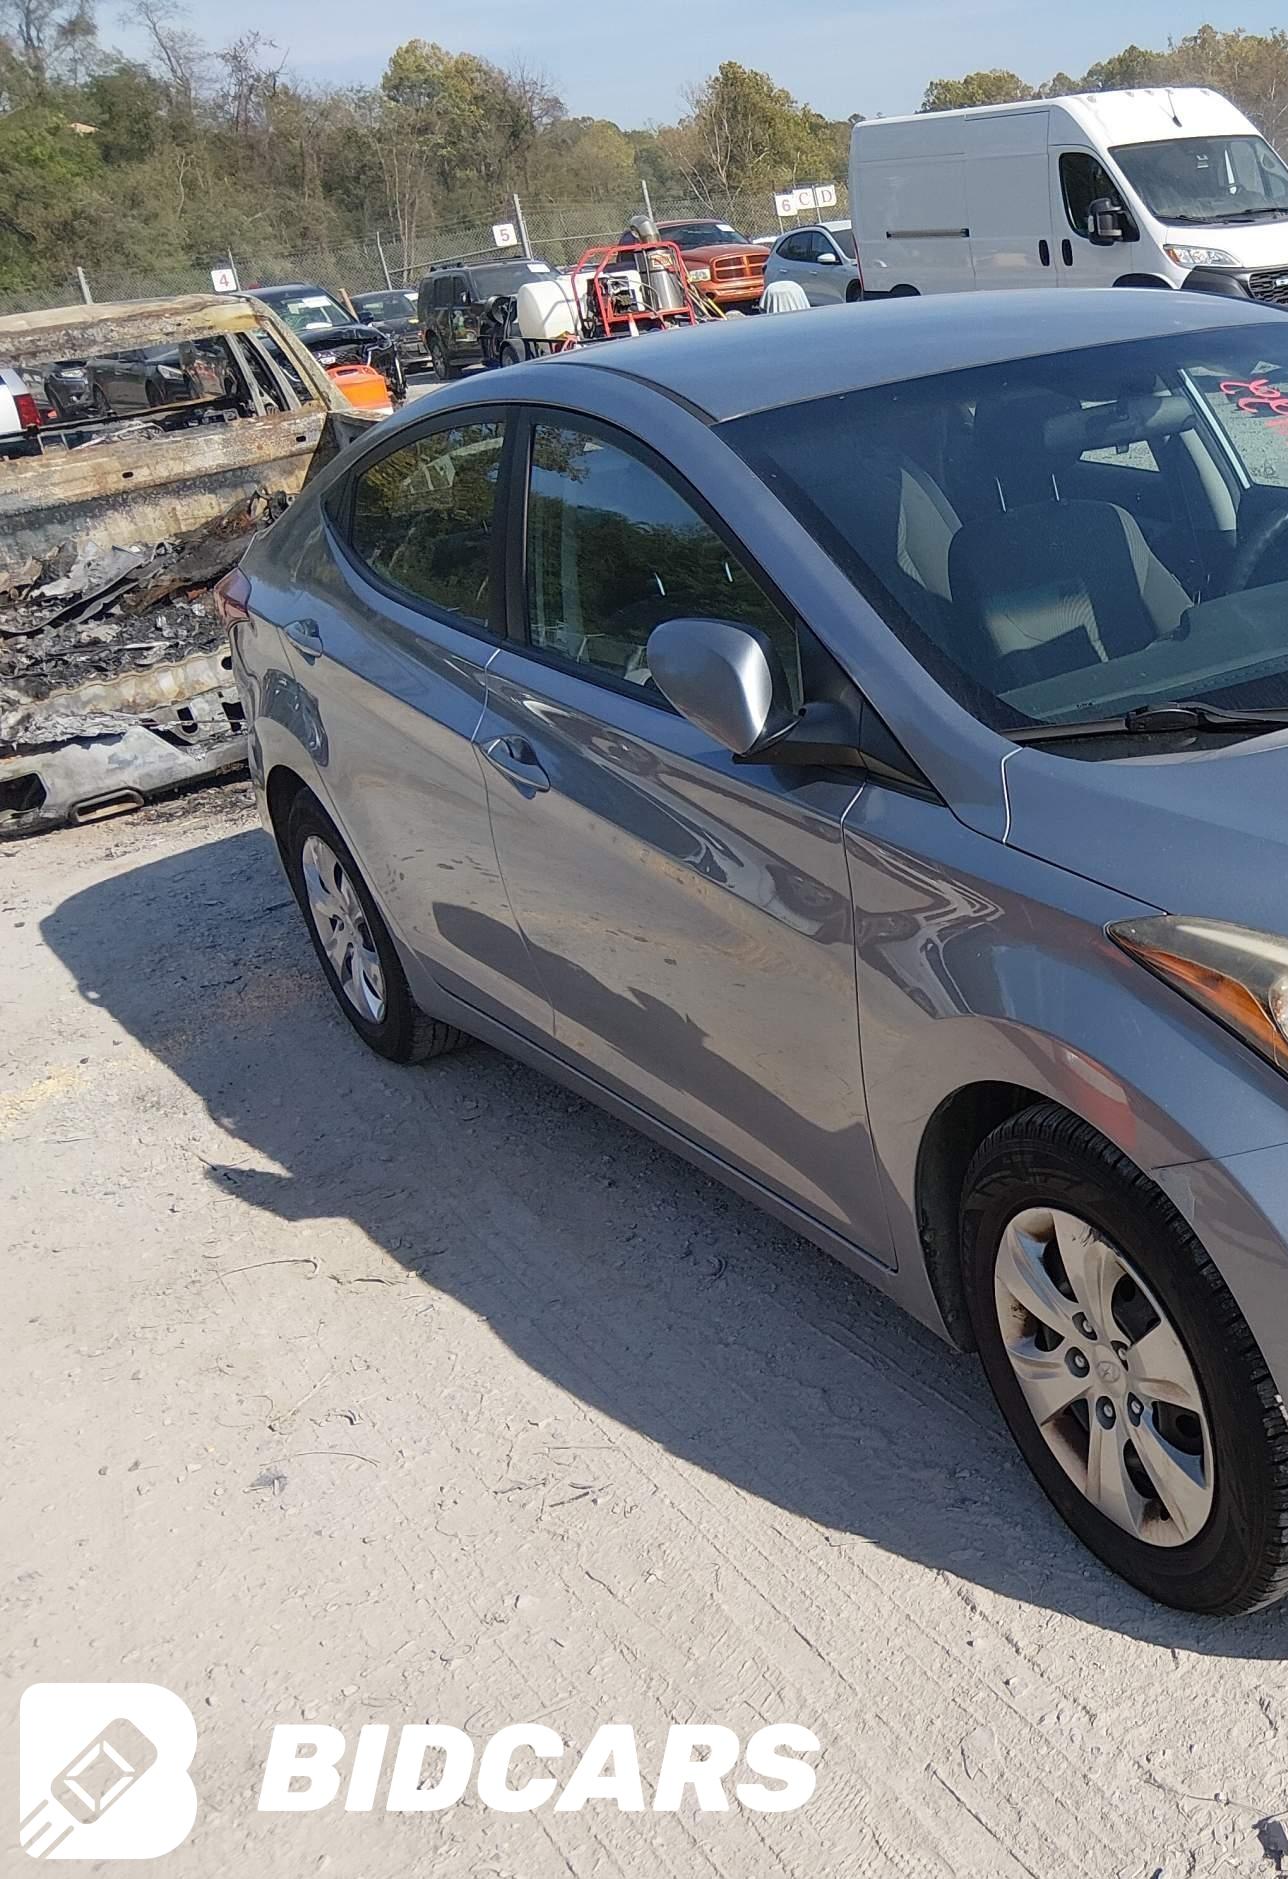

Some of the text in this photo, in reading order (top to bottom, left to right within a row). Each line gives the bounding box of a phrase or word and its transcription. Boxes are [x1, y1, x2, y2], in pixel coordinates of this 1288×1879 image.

[782, 189, 832, 212] 6 C D
[500, 229, 510, 241] 5
[219, 273, 230, 287] 4
